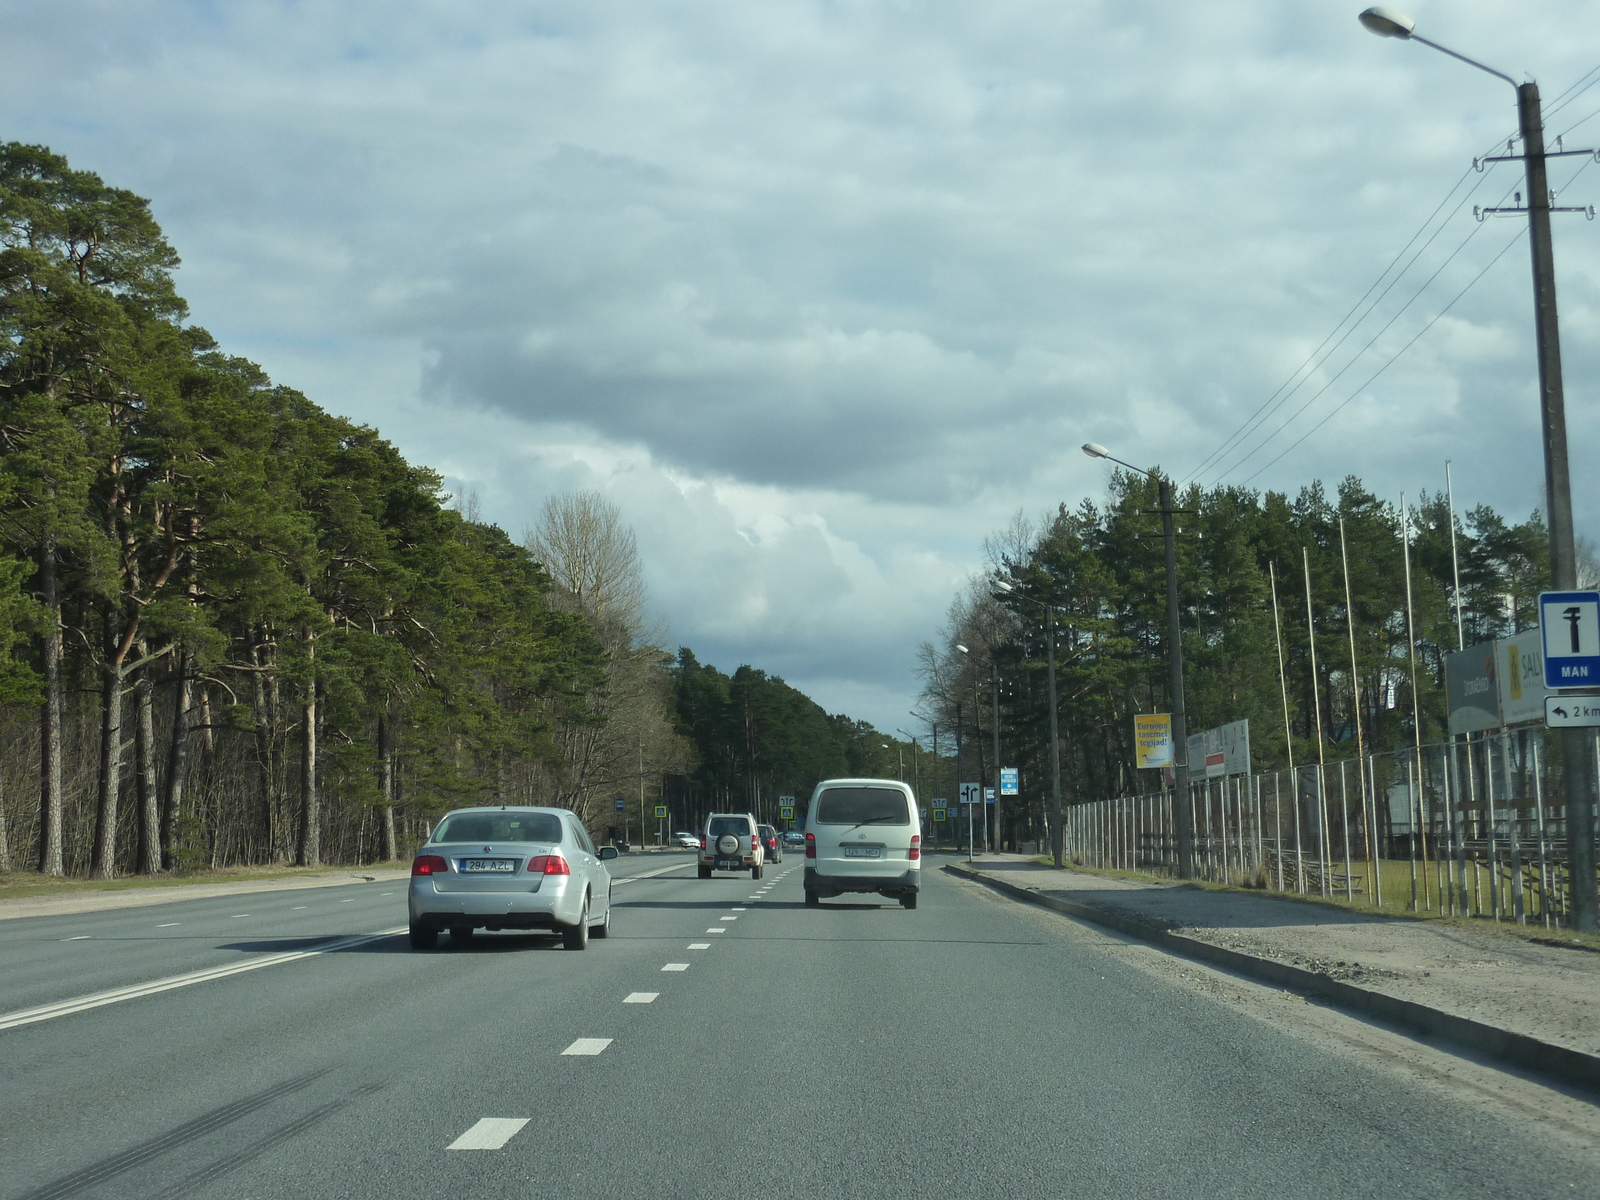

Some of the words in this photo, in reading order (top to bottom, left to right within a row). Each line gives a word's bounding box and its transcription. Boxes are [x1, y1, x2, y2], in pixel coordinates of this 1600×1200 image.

[1561, 666, 1588, 678] MAN
[1573, 706, 1580, 717] 2
[1583, 705, 1600, 717] km
[1137, 723, 1168, 731] Euroopa
[1138, 730, 1168, 738] tasemel
[1140, 738, 1167, 748] tegijad!
[469, 861, 486, 870] 294
[490, 861, 510, 870] AZL
